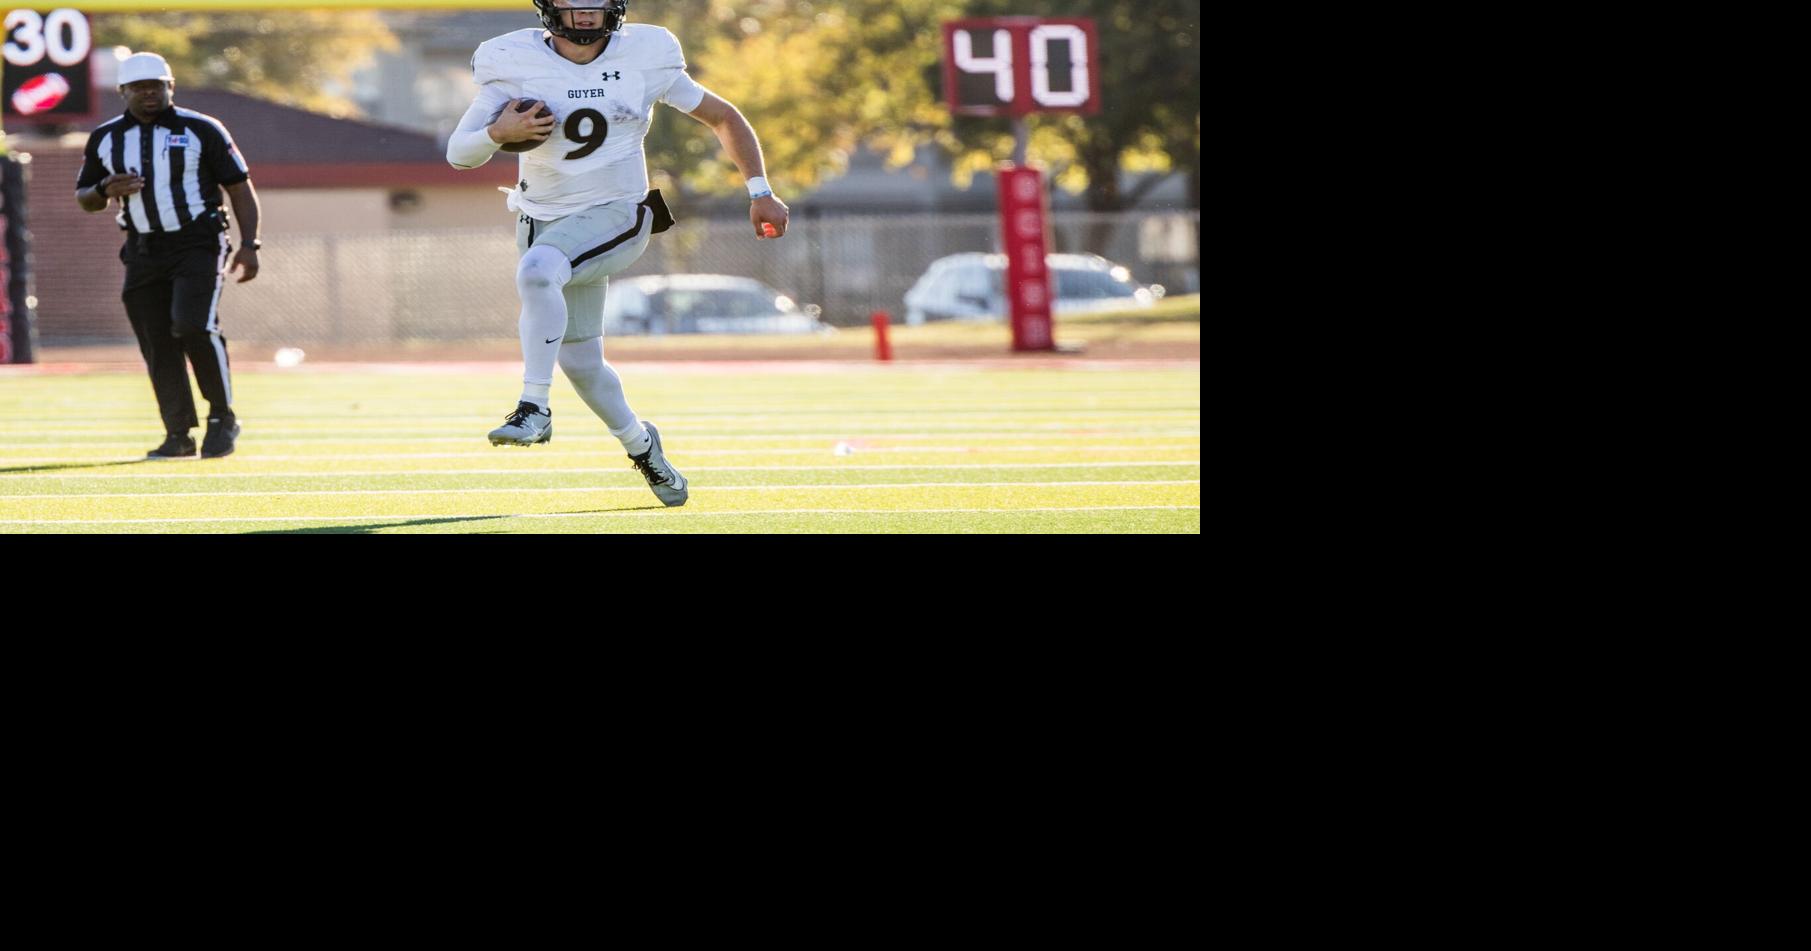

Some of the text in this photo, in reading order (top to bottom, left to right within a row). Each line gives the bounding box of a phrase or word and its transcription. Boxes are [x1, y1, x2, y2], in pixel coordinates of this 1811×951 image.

[3, 8, 91, 66] 30
[953, 24, 1090, 107] 40
[567, 88, 605, 99] GUYER
[564, 108, 608, 160] 9
